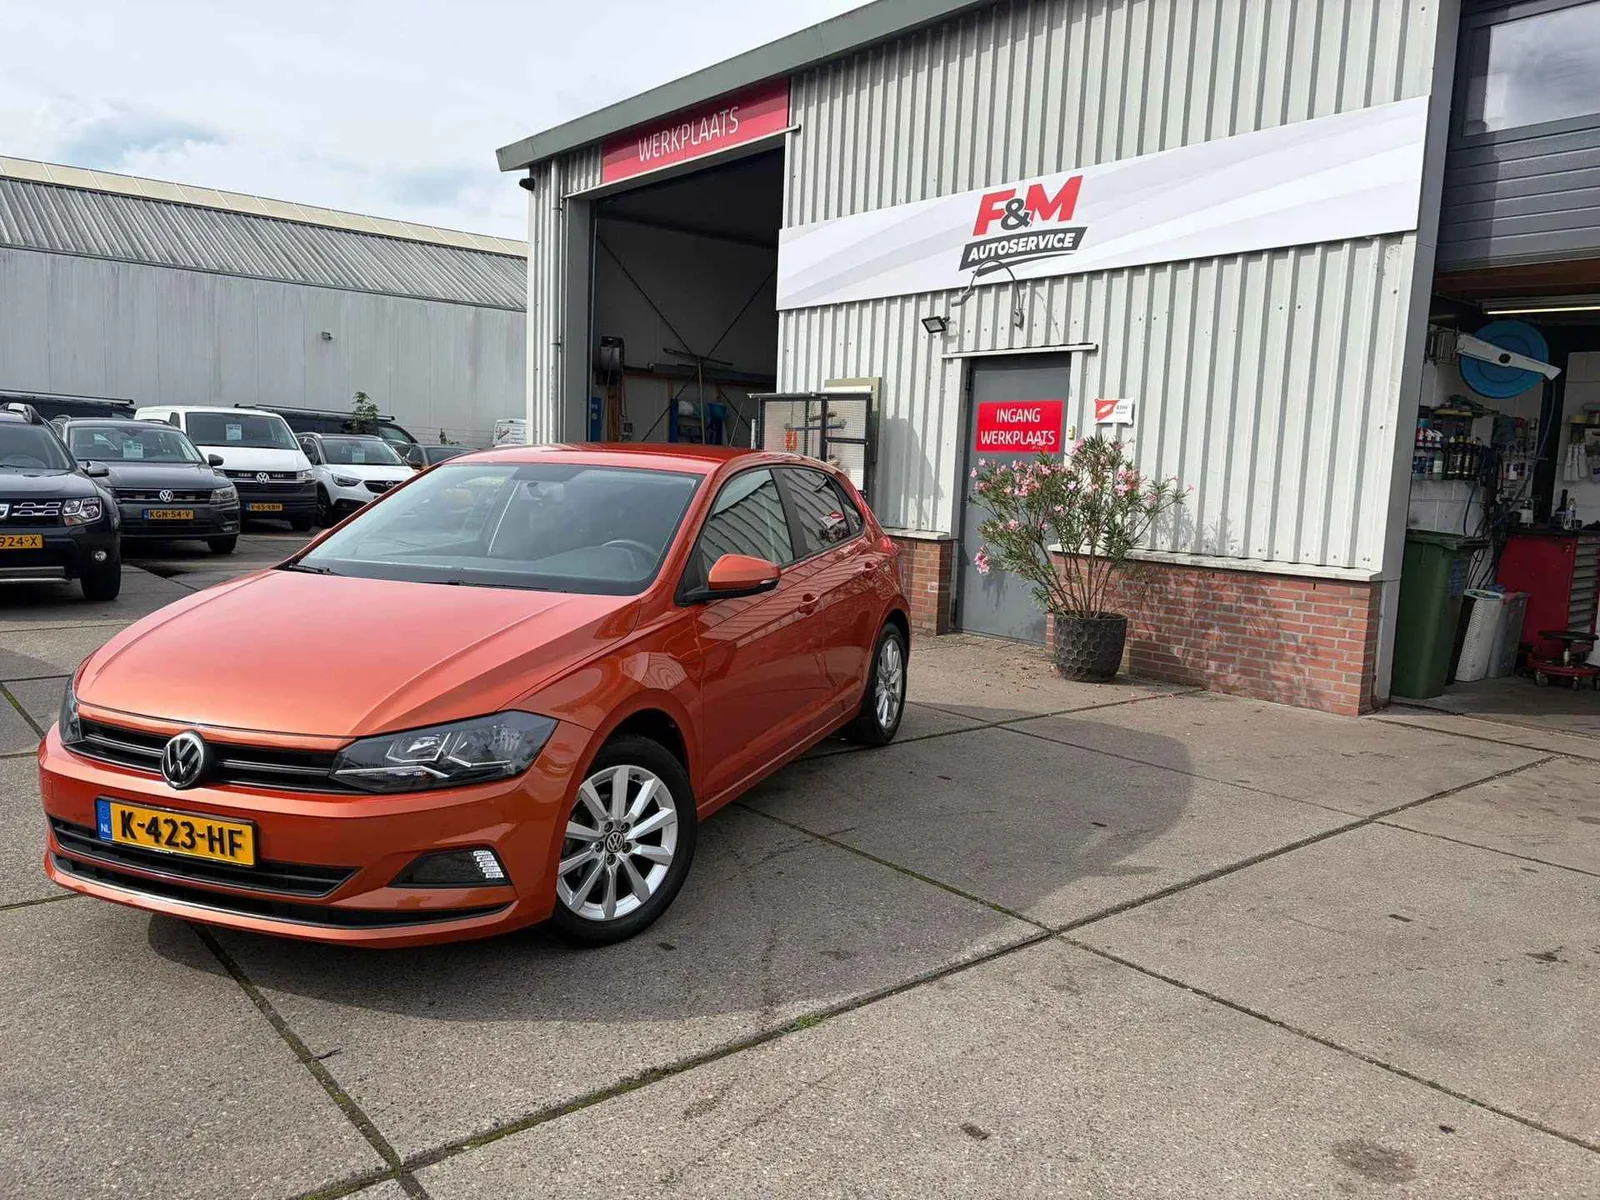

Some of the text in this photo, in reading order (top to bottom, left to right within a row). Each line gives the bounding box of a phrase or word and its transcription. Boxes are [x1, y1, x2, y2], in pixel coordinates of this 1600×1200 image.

[638, 106, 739, 162] WERKPLAATS
[972, 175, 1083, 236] F&M
[967, 232, 1076, 262] AUTOSERVICE
[996, 408, 1041, 423] INGANG
[980, 430, 1056, 445] WERKPLAATS
[100, 823, 111, 834] NL
[120, 809, 243, 857] K-423-HF
